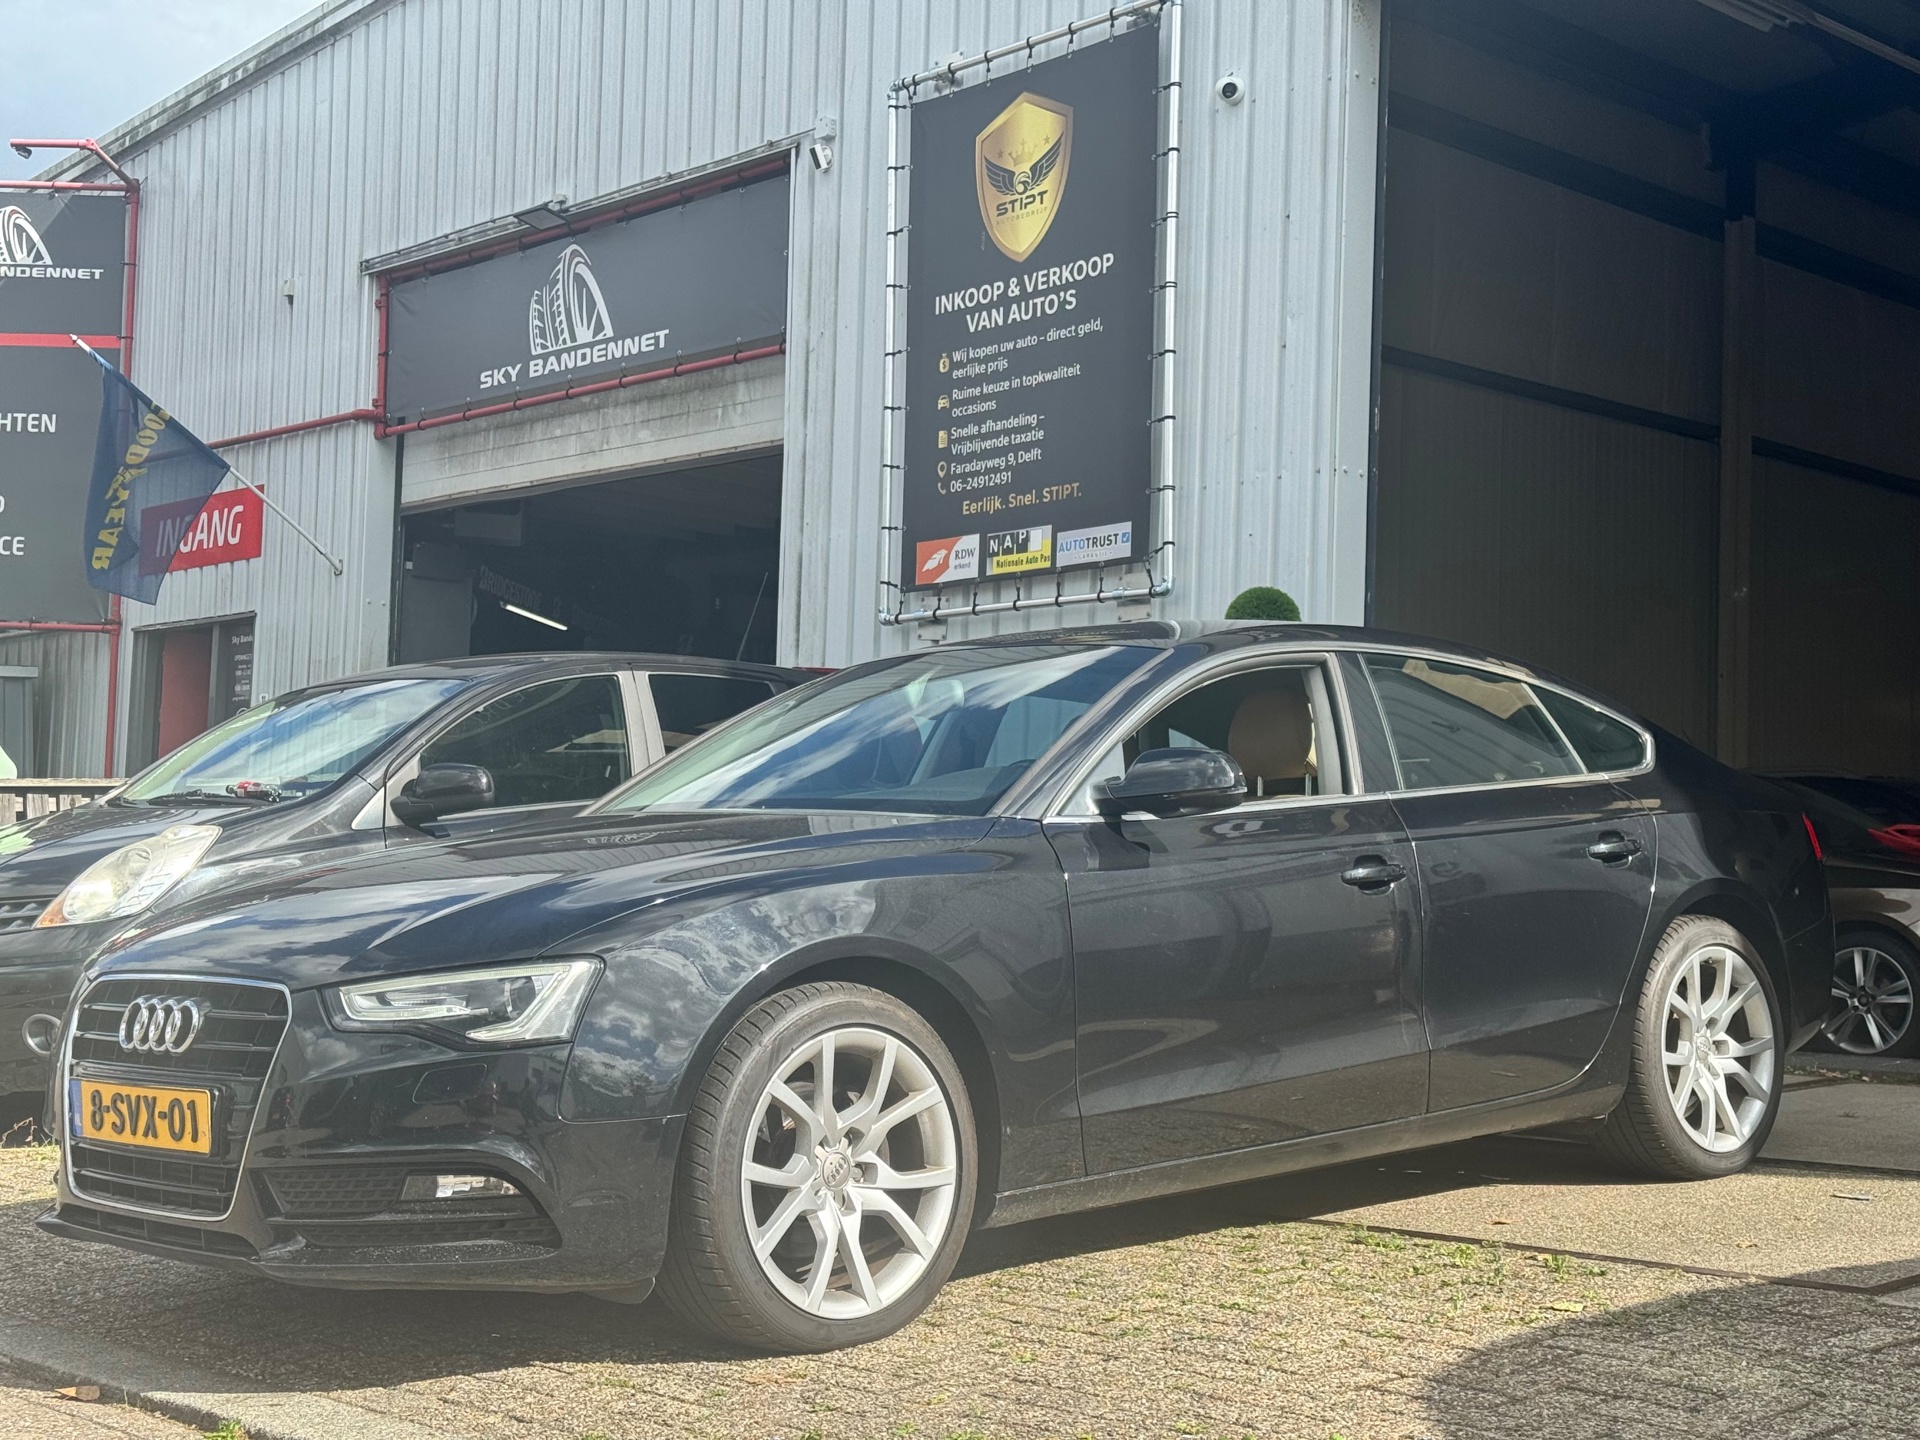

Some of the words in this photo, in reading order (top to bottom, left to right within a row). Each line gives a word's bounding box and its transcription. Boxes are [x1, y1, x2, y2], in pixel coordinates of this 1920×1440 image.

[996, 189, 1049, 218] STIPT
[935, 281, 1005, 315] INKOOP
[1007, 277, 1021, 298] &
[1023, 253, 1115, 294] VERKOOP
[966, 306, 1004, 334] VAN
[1007, 289, 1077, 325] AUTO'S
[952, 348, 967, 363] Wij
[969, 344, 999, 360] kopen
[1000, 340, 1015, 352] uw
[1016, 335, 1038, 349] auto
[1046, 324, 1076, 342] direct
[1077, 317, 1104, 338] geld,
[479, 363, 523, 389] SKY
[528, 329, 670, 379] BANDENNET
[952, 363, 986, 380] eerlijke
[987, 357, 1008, 376] prijs
[952, 385, 981, 401] Ruime
[983, 380, 1010, 395] keuze
[1011, 376, 1021, 388] in
[1022, 363, 1081, 387] topkwaliteit
[951, 399, 997, 418] occasions
[950, 423, 979, 439] Snelle
[980, 413, 1038, 434] afhandeling
[951, 434, 1010, 456] Vrijblijvende
[1011, 427, 1045, 445] taxatie
[950, 456, 1006, 475] Faradayweg
[1007, 452, 1017, 467] 9,
[1018, 447, 1042, 464] Delft
[950, 471, 1012, 493] 06-24912491
[962, 495, 1006, 515] Eerlijk.
[1008, 489, 1040, 508] Snel.
[1042, 482, 1082, 503] STIPT.
[155, 505, 244, 558] INGANG
[1058, 533, 1120, 553] AUTOTRUST
[953, 561, 971, 571] erkend
[954, 547, 977, 560] RDW
[996, 557, 1024, 568] Nationale
[1025, 555, 1039, 565] Auto
[90, 1089, 199, 1143] 8-SVX-01
